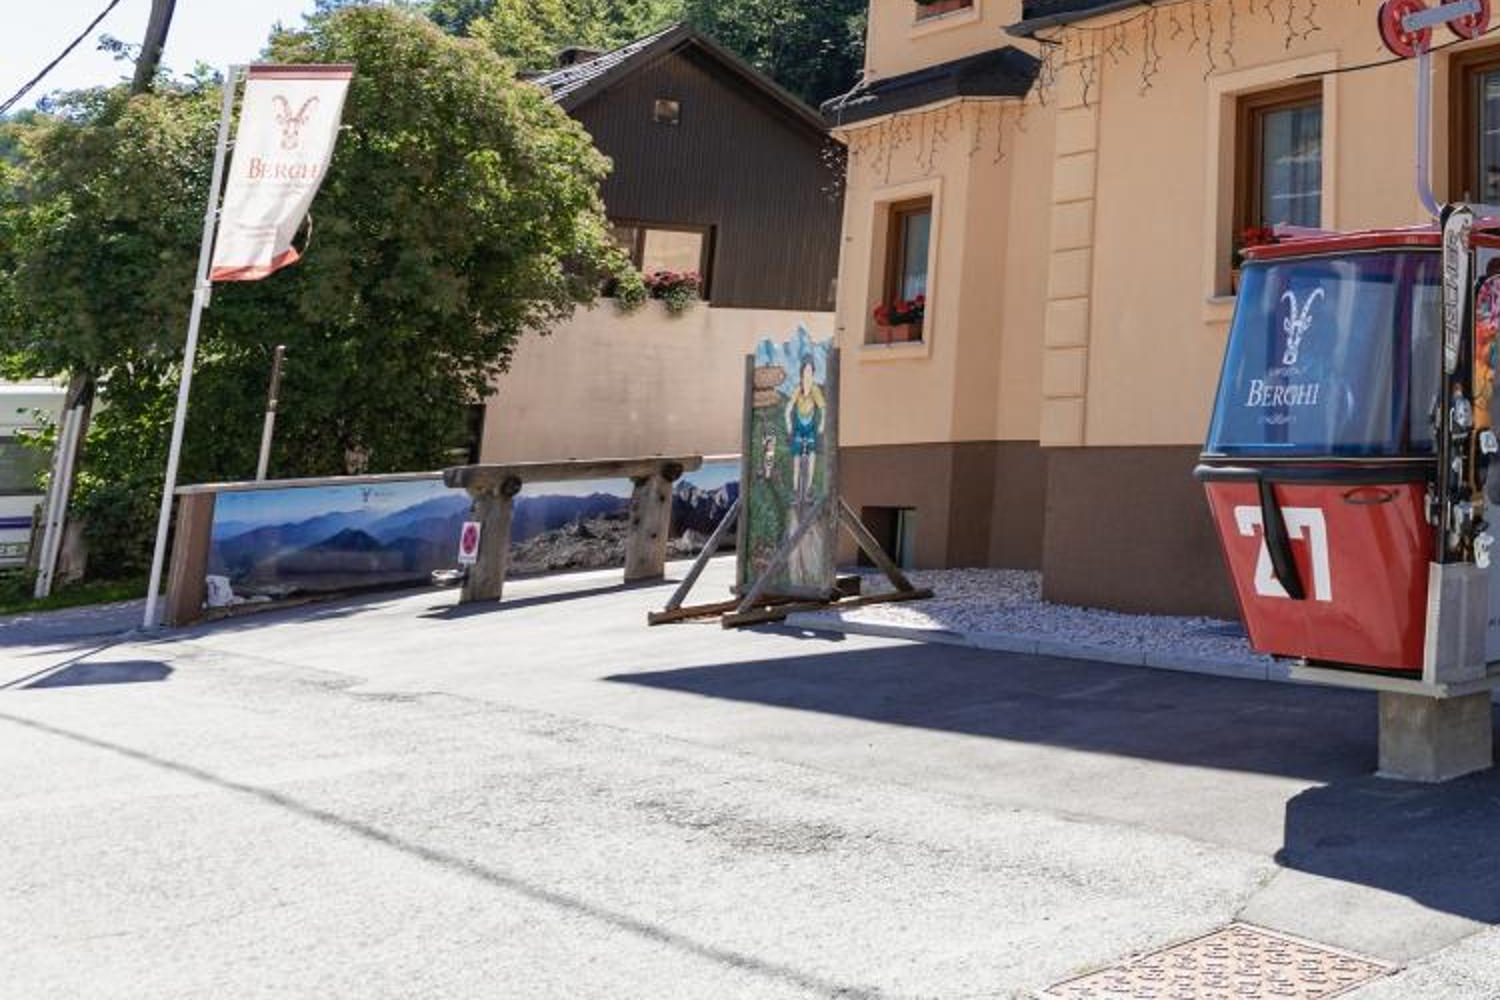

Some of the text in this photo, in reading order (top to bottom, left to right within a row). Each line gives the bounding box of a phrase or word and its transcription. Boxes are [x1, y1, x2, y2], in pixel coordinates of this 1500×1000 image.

[249, 157, 321, 180] BERGH
[1245, 379, 1320, 407] BERGHI
[1233, 504, 1332, 602] 27
